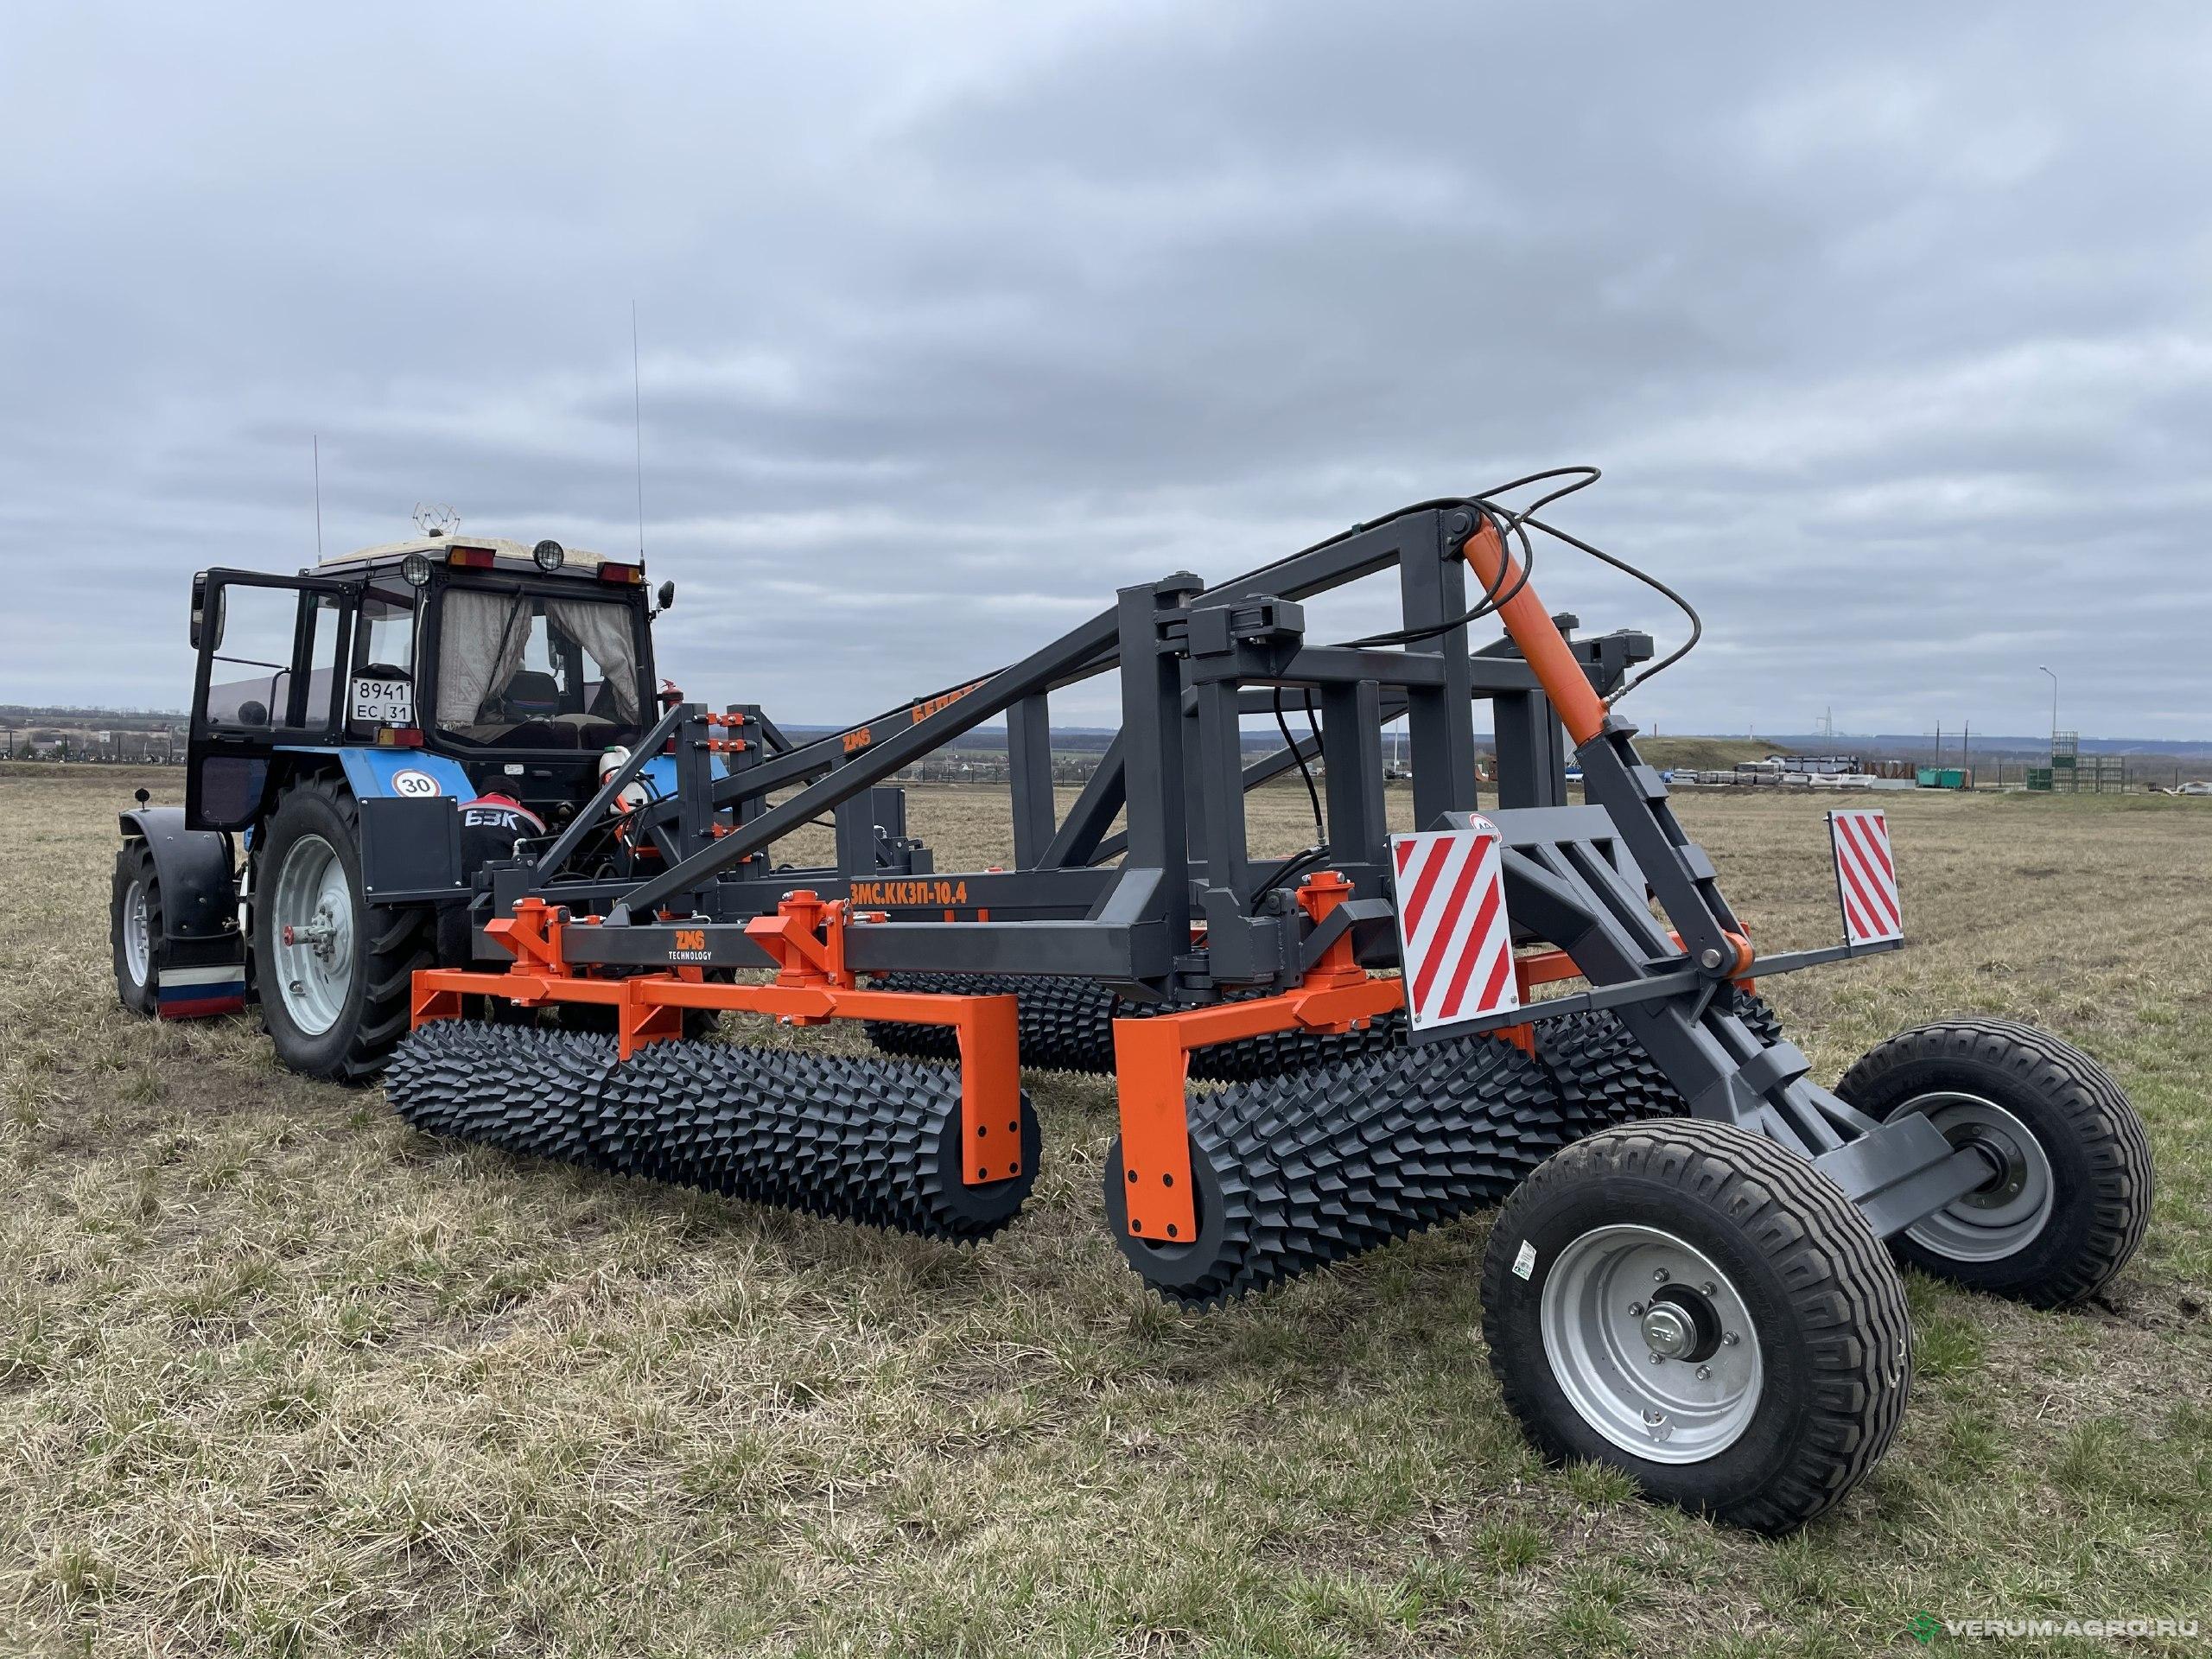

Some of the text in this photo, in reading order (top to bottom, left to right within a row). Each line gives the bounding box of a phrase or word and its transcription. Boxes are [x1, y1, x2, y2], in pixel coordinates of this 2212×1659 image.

[359, 682, 404, 701] 8941
[390, 706, 406, 720] 31
[842, 727, 871, 753] ZMS
[402, 779, 431, 793] 30
[675, 930, 705, 950] ZMS
[668, 950, 712, 961] TECHNOLOGY
